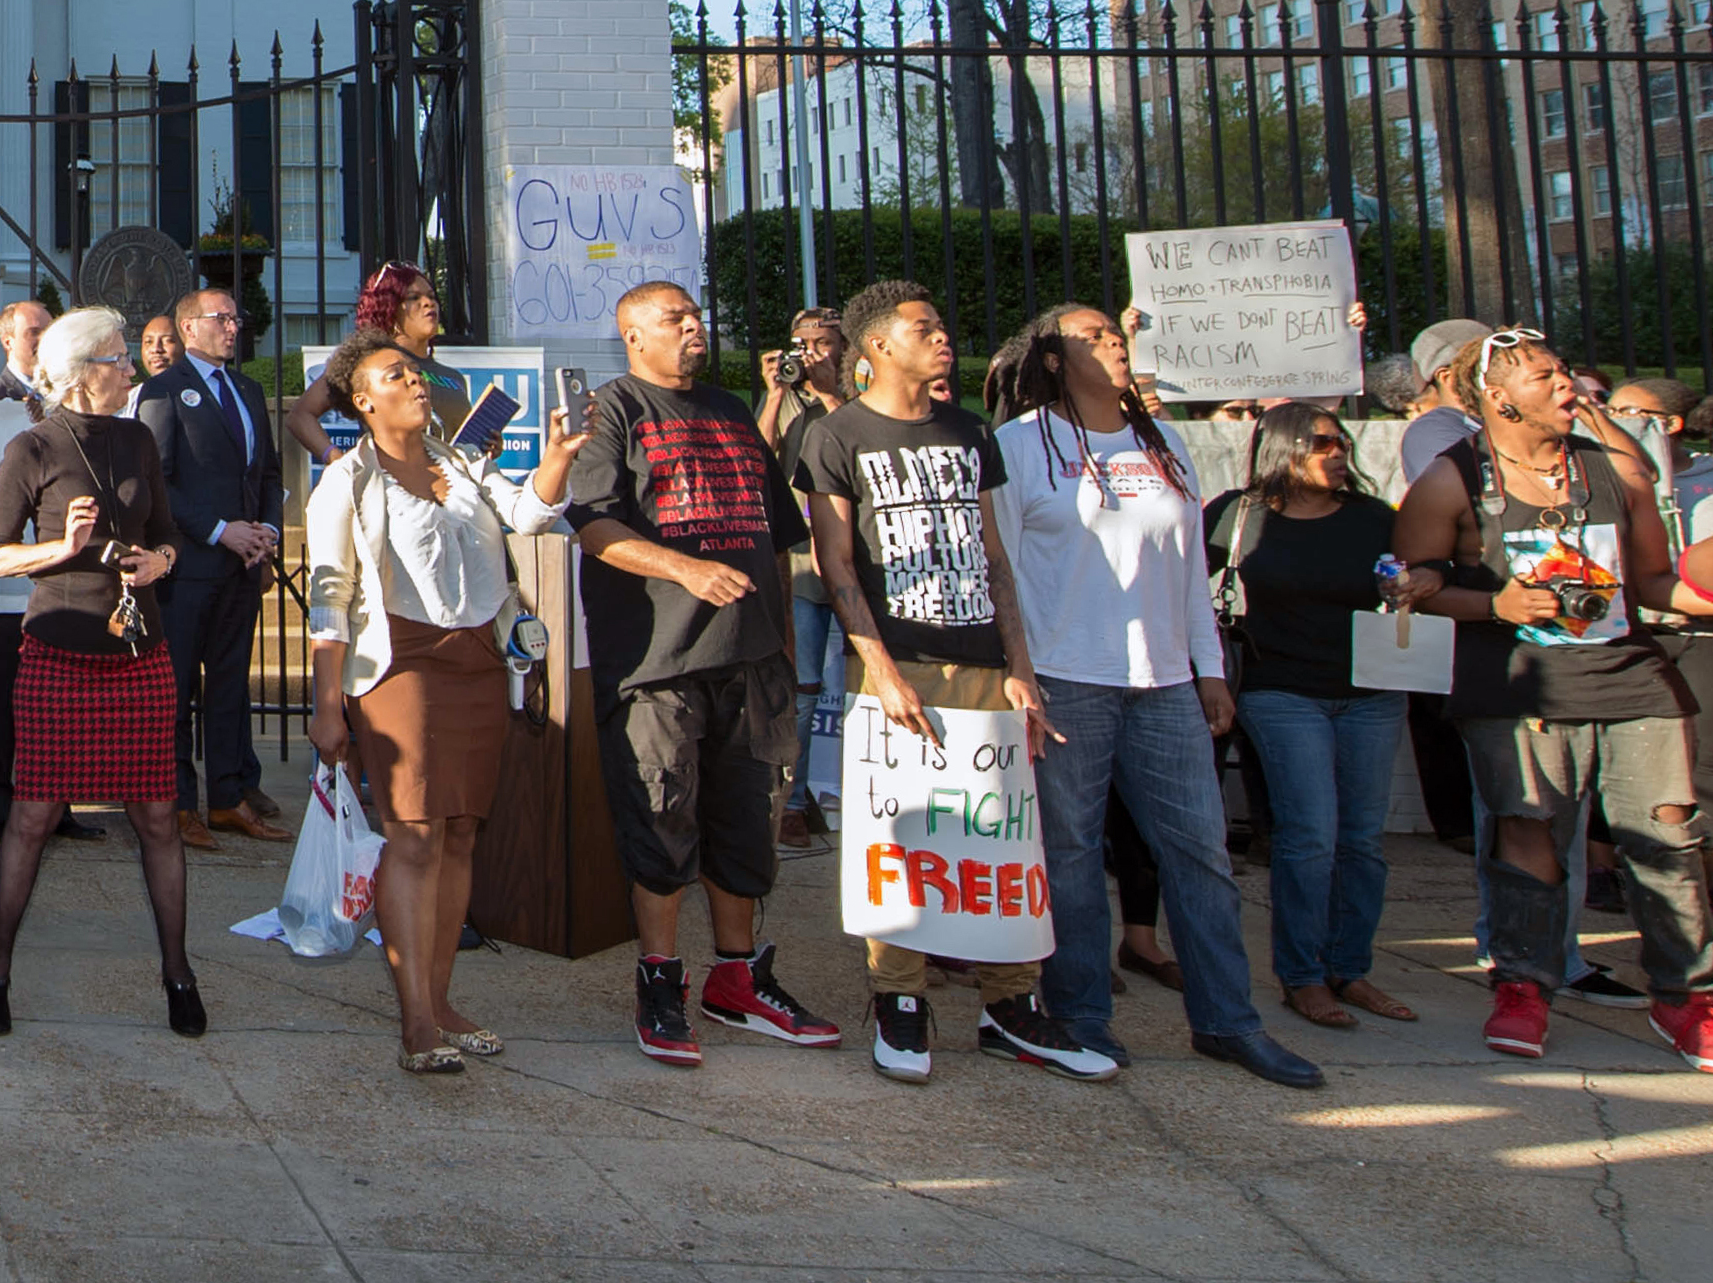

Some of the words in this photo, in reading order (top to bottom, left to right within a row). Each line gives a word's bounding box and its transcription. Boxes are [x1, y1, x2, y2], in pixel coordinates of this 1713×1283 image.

[1146, 241, 1193, 270] WE
[1208, 237, 1264, 265] CANT
[1276, 236, 1335, 263] BEAT
[1160, 315, 1182, 336] IF
[1191, 313, 1225, 333] WE
[1238, 308, 1277, 329] DONT
[1286, 306, 1341, 343] BEAT
[1153, 341, 1260, 371] RACISM
[700, 537, 755, 552] ATLANTA
[859, 706, 899, 769] It
[869, 773, 900, 819] to
[926, 788, 1036, 842] FIGHT
